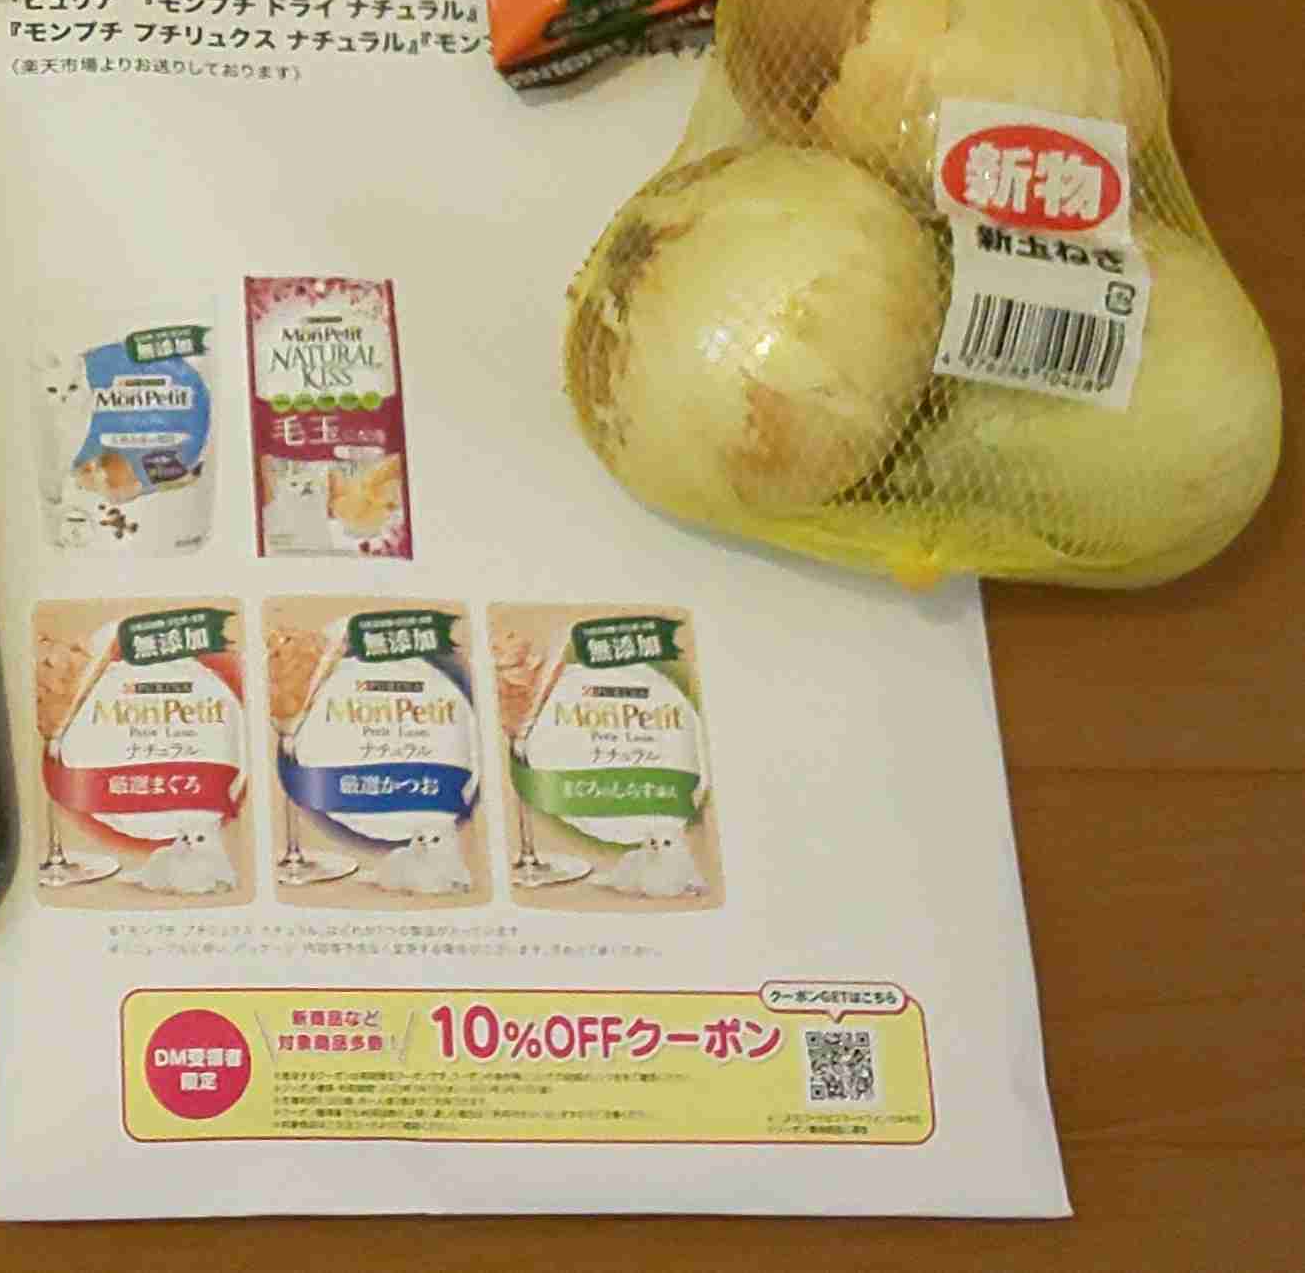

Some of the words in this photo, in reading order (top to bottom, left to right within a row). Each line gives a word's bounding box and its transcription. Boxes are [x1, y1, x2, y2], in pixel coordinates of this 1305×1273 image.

[964, 140, 1104, 221] 新物
[271, 415, 342, 447] 毛玉
[132, 627, 209, 660] 無添加
[362, 627, 439, 657] 無添加
[586, 632, 662, 662] 無添加
[125, 741, 200, 760] ナチュラル
[292, 1009, 380, 1027] 新商品など
[430, 1004, 783, 1061] 10%OFFクーポン
